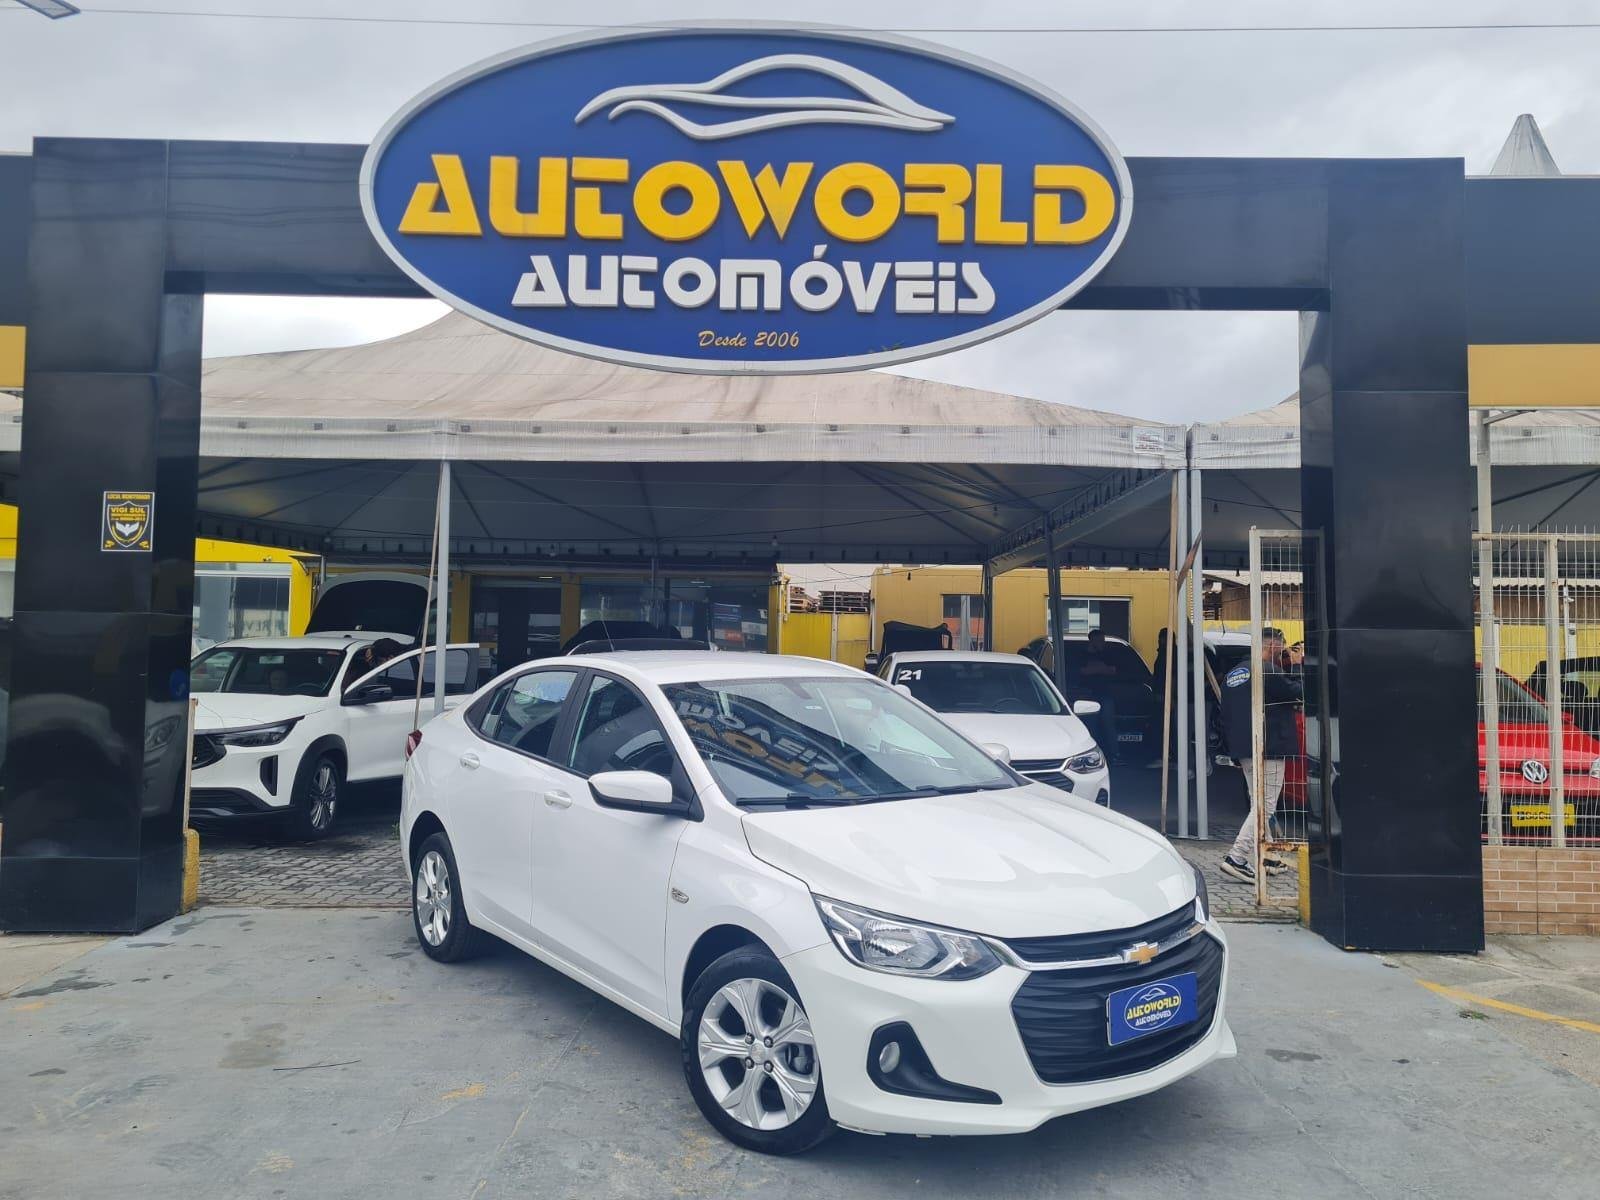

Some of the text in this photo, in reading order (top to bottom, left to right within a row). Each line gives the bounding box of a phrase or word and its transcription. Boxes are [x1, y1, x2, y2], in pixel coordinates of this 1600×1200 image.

[399, 154, 1116, 245] AUTOWORLD
[511, 245, 996, 314] AUTOMÓVEIS
[698, 330, 800, 347] Desde 2006
[899, 669, 922, 680] 21
[1126, 995, 1180, 1020] AUTOWORLD
